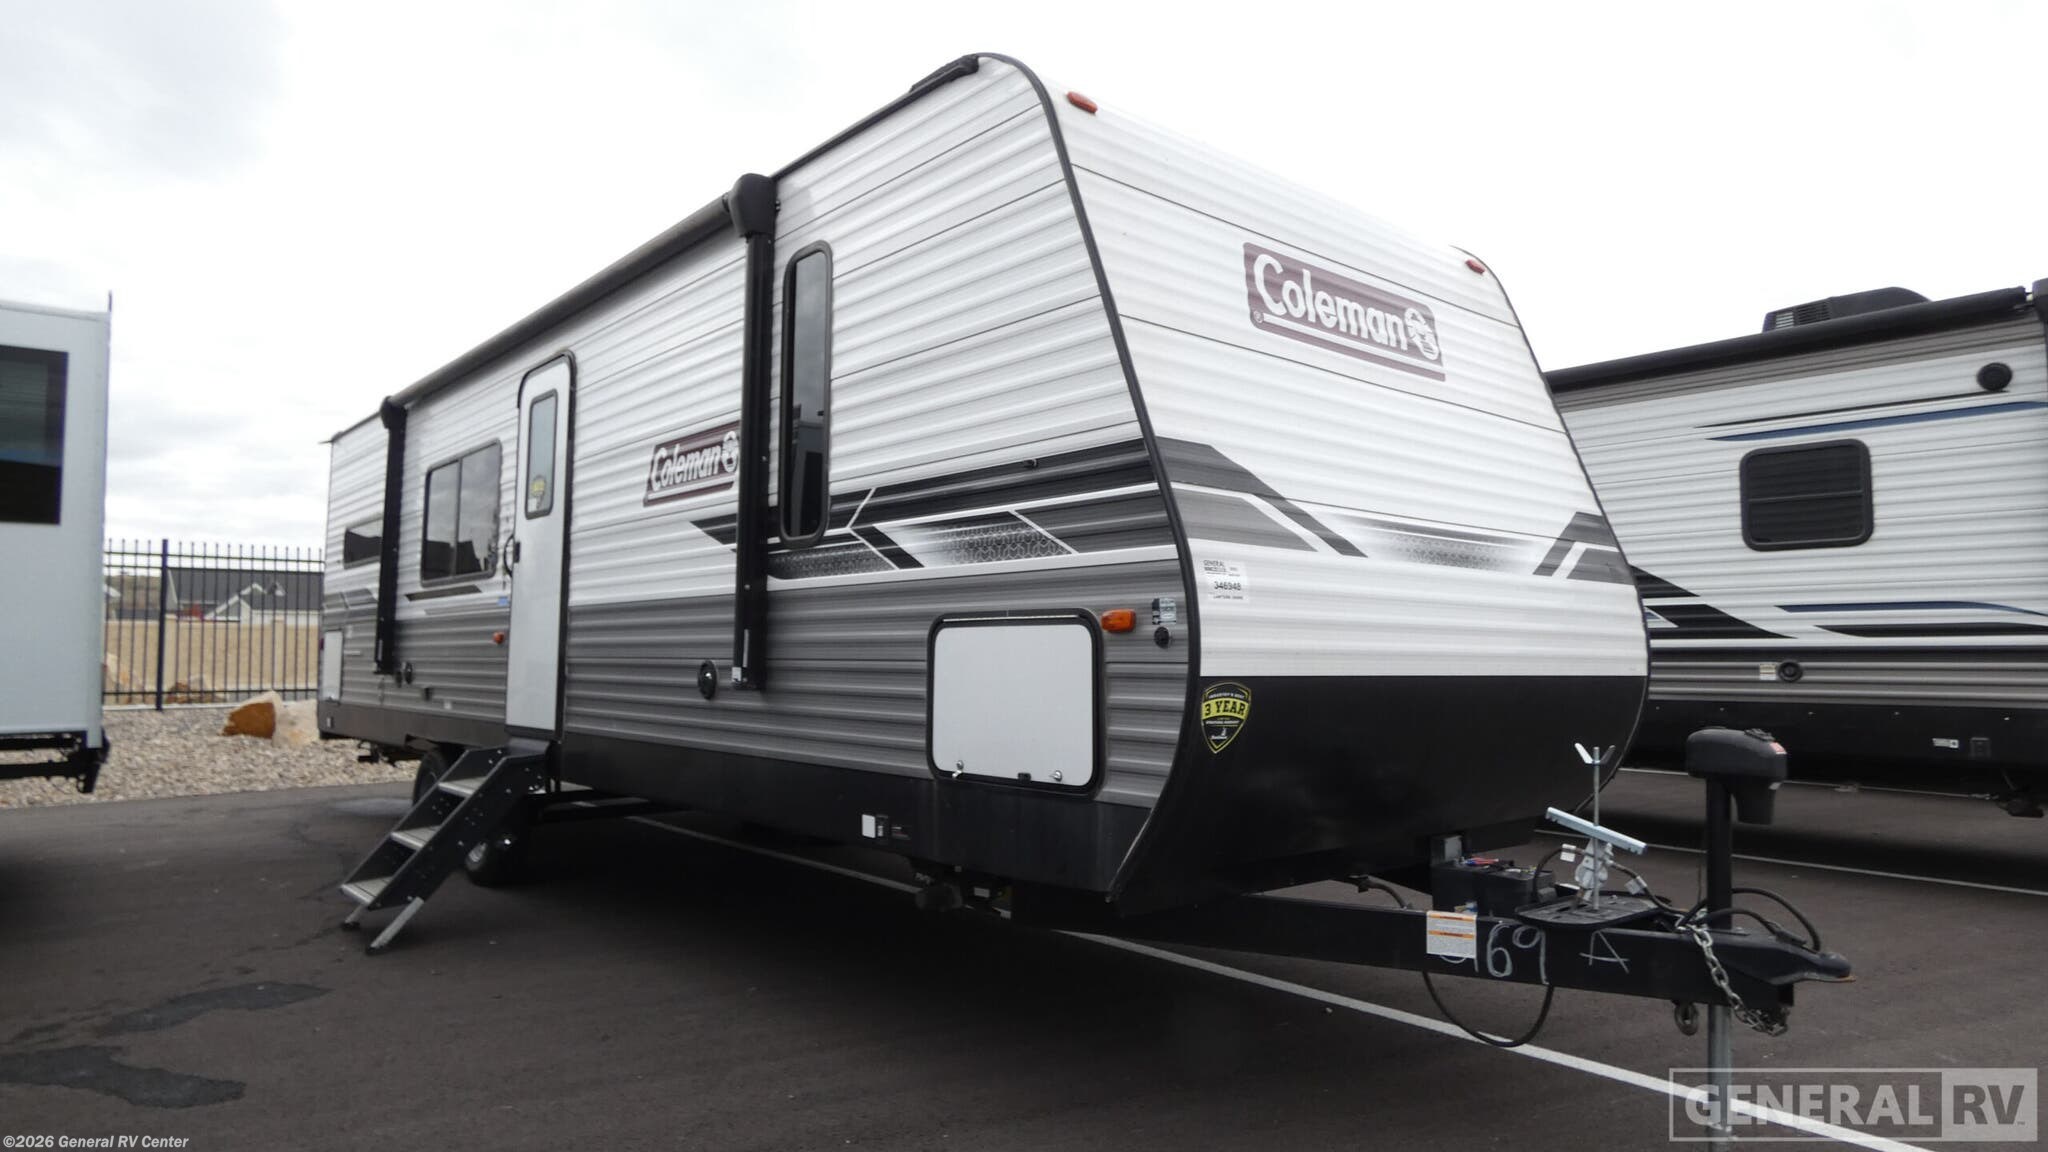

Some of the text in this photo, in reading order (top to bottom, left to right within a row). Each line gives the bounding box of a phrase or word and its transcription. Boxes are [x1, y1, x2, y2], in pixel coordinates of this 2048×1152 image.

[1253, 253, 1408, 351] Coleman
[650, 443, 722, 492] Coleman
[1204, 700, 1246, 717] 3 YEAR
